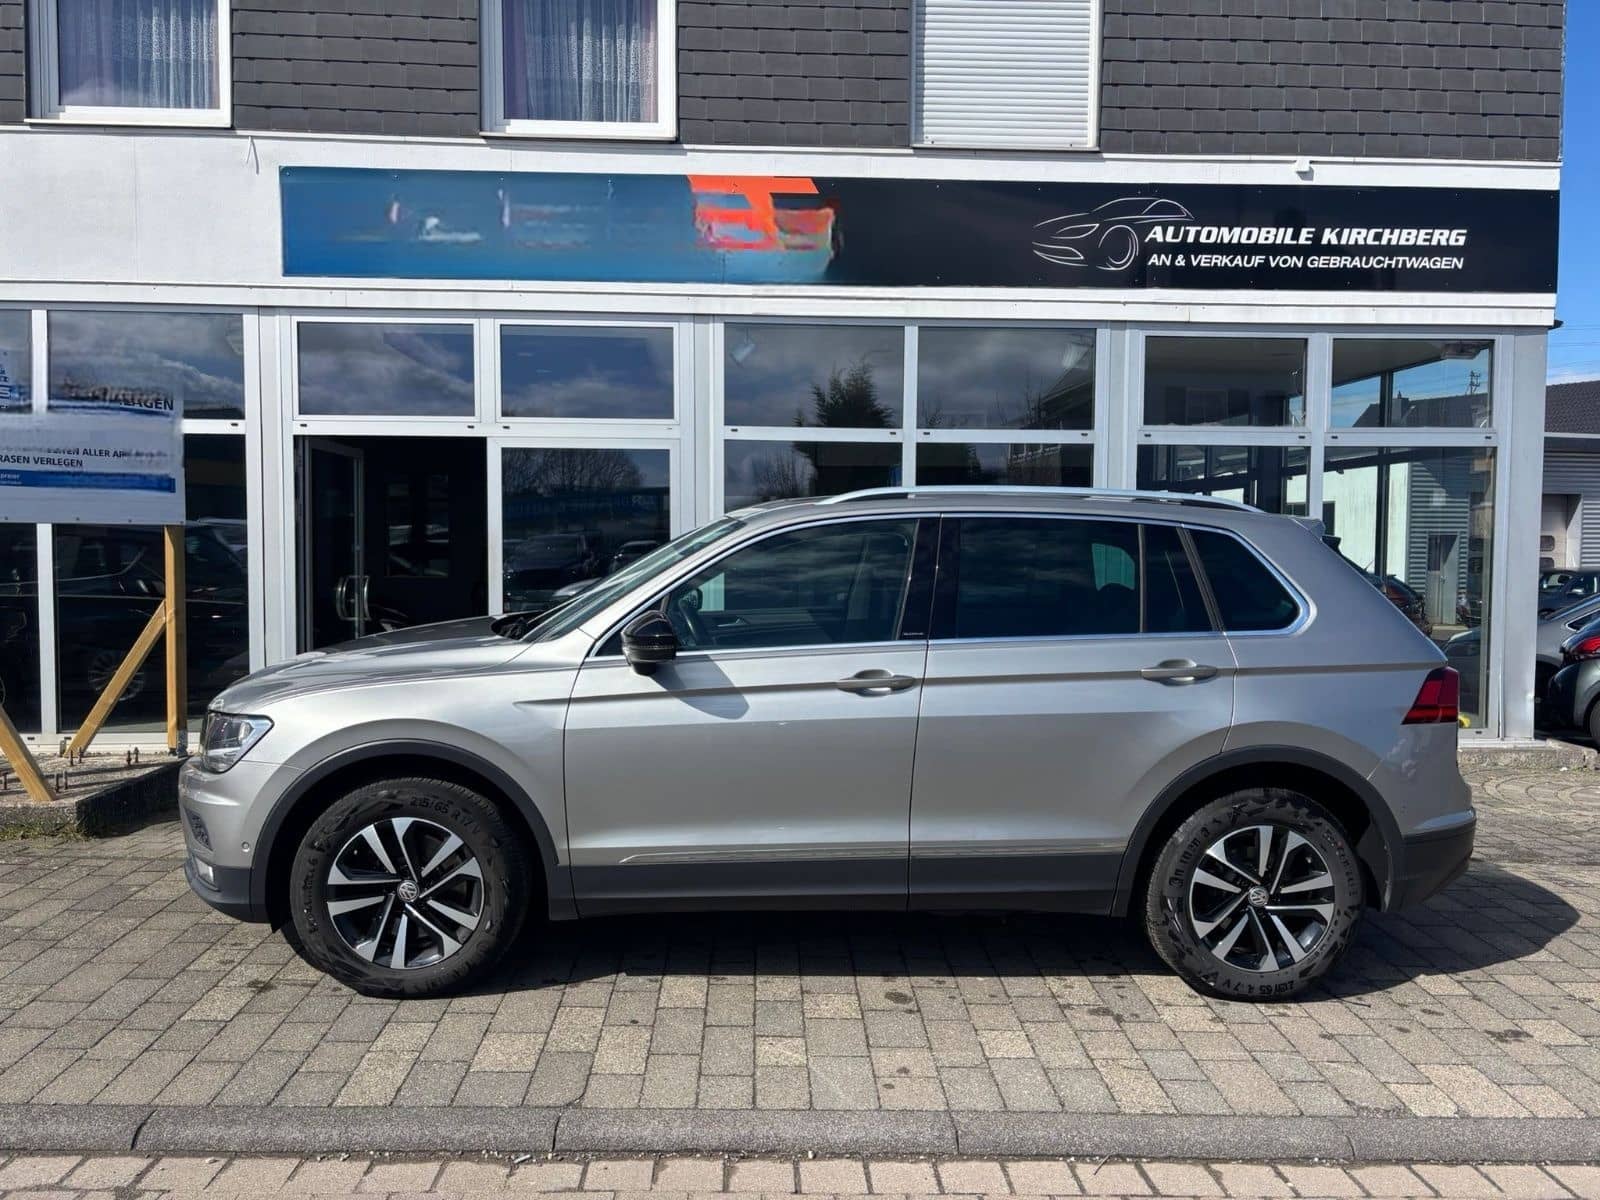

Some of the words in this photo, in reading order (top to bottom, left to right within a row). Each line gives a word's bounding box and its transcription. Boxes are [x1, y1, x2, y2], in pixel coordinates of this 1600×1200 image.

[1144, 225, 1316, 246] AUTOMOBILE
[1321, 227, 1468, 247] KIRCHBERG
[1148, 253, 1172, 267] AN
[1175, 253, 1186, 267] &
[1190, 254, 1266, 268] VERKAUF
[1269, 255, 1304, 269] VON
[1306, 255, 1465, 270] GEBRAUCHTWAGEN
[82, 447, 111, 458] ALLER
[33, 456, 84, 467] VERLEGEN
